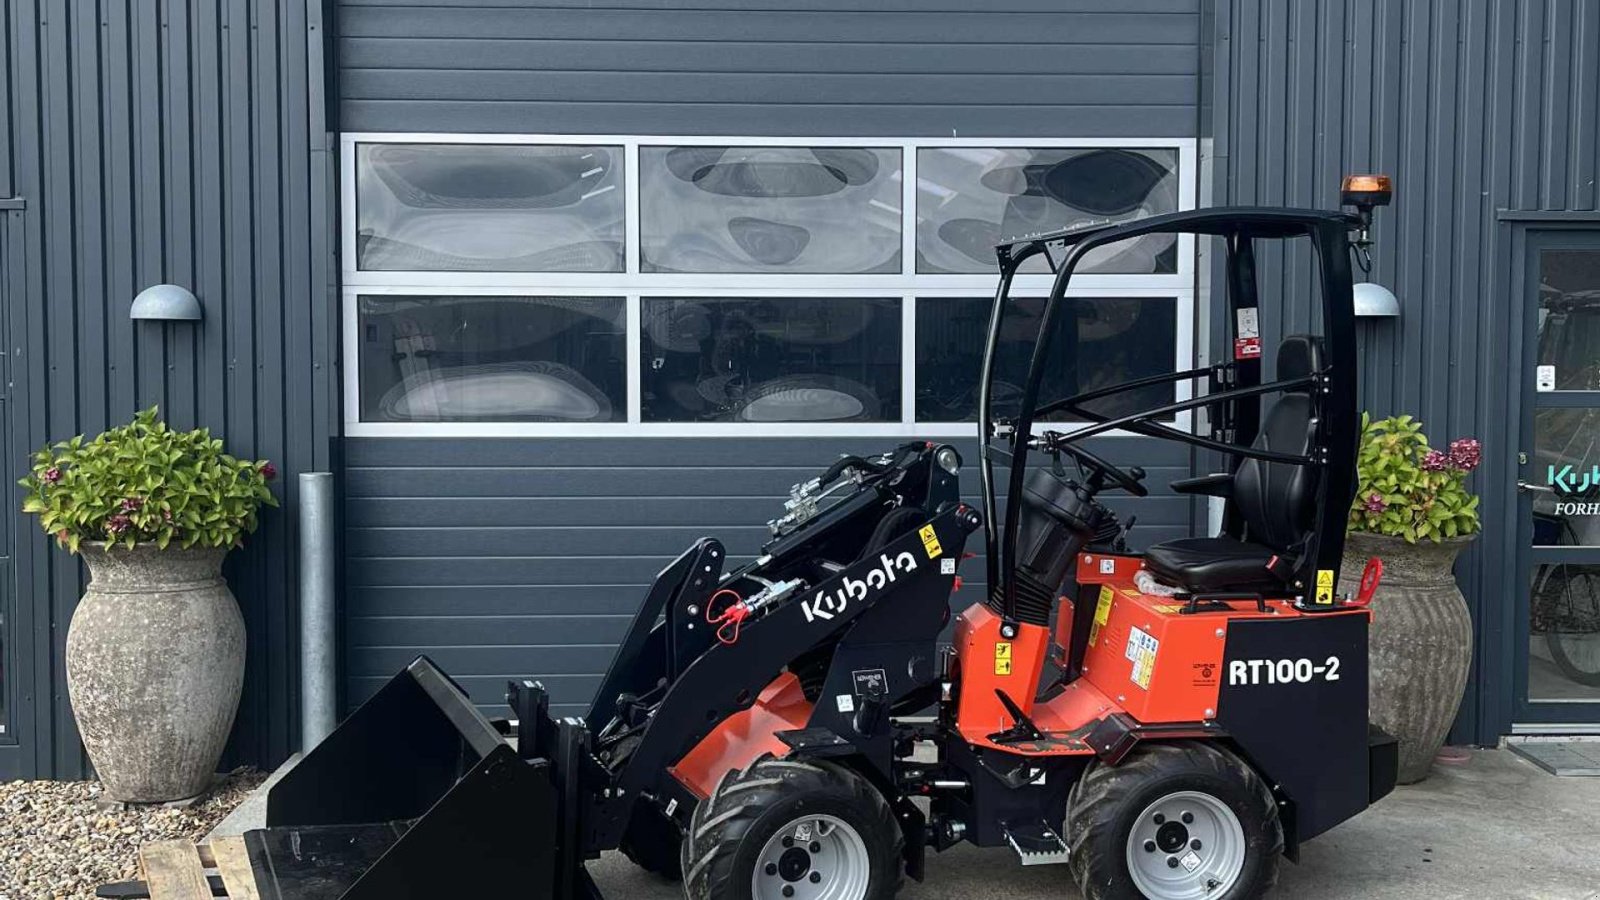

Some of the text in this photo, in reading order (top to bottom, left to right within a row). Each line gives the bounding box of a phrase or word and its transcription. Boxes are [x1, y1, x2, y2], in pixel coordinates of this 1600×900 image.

[1554, 502, 1600, 516] FORH
[800, 551, 917, 623] Kubota
[1229, 656, 1340, 686] RT100-2
